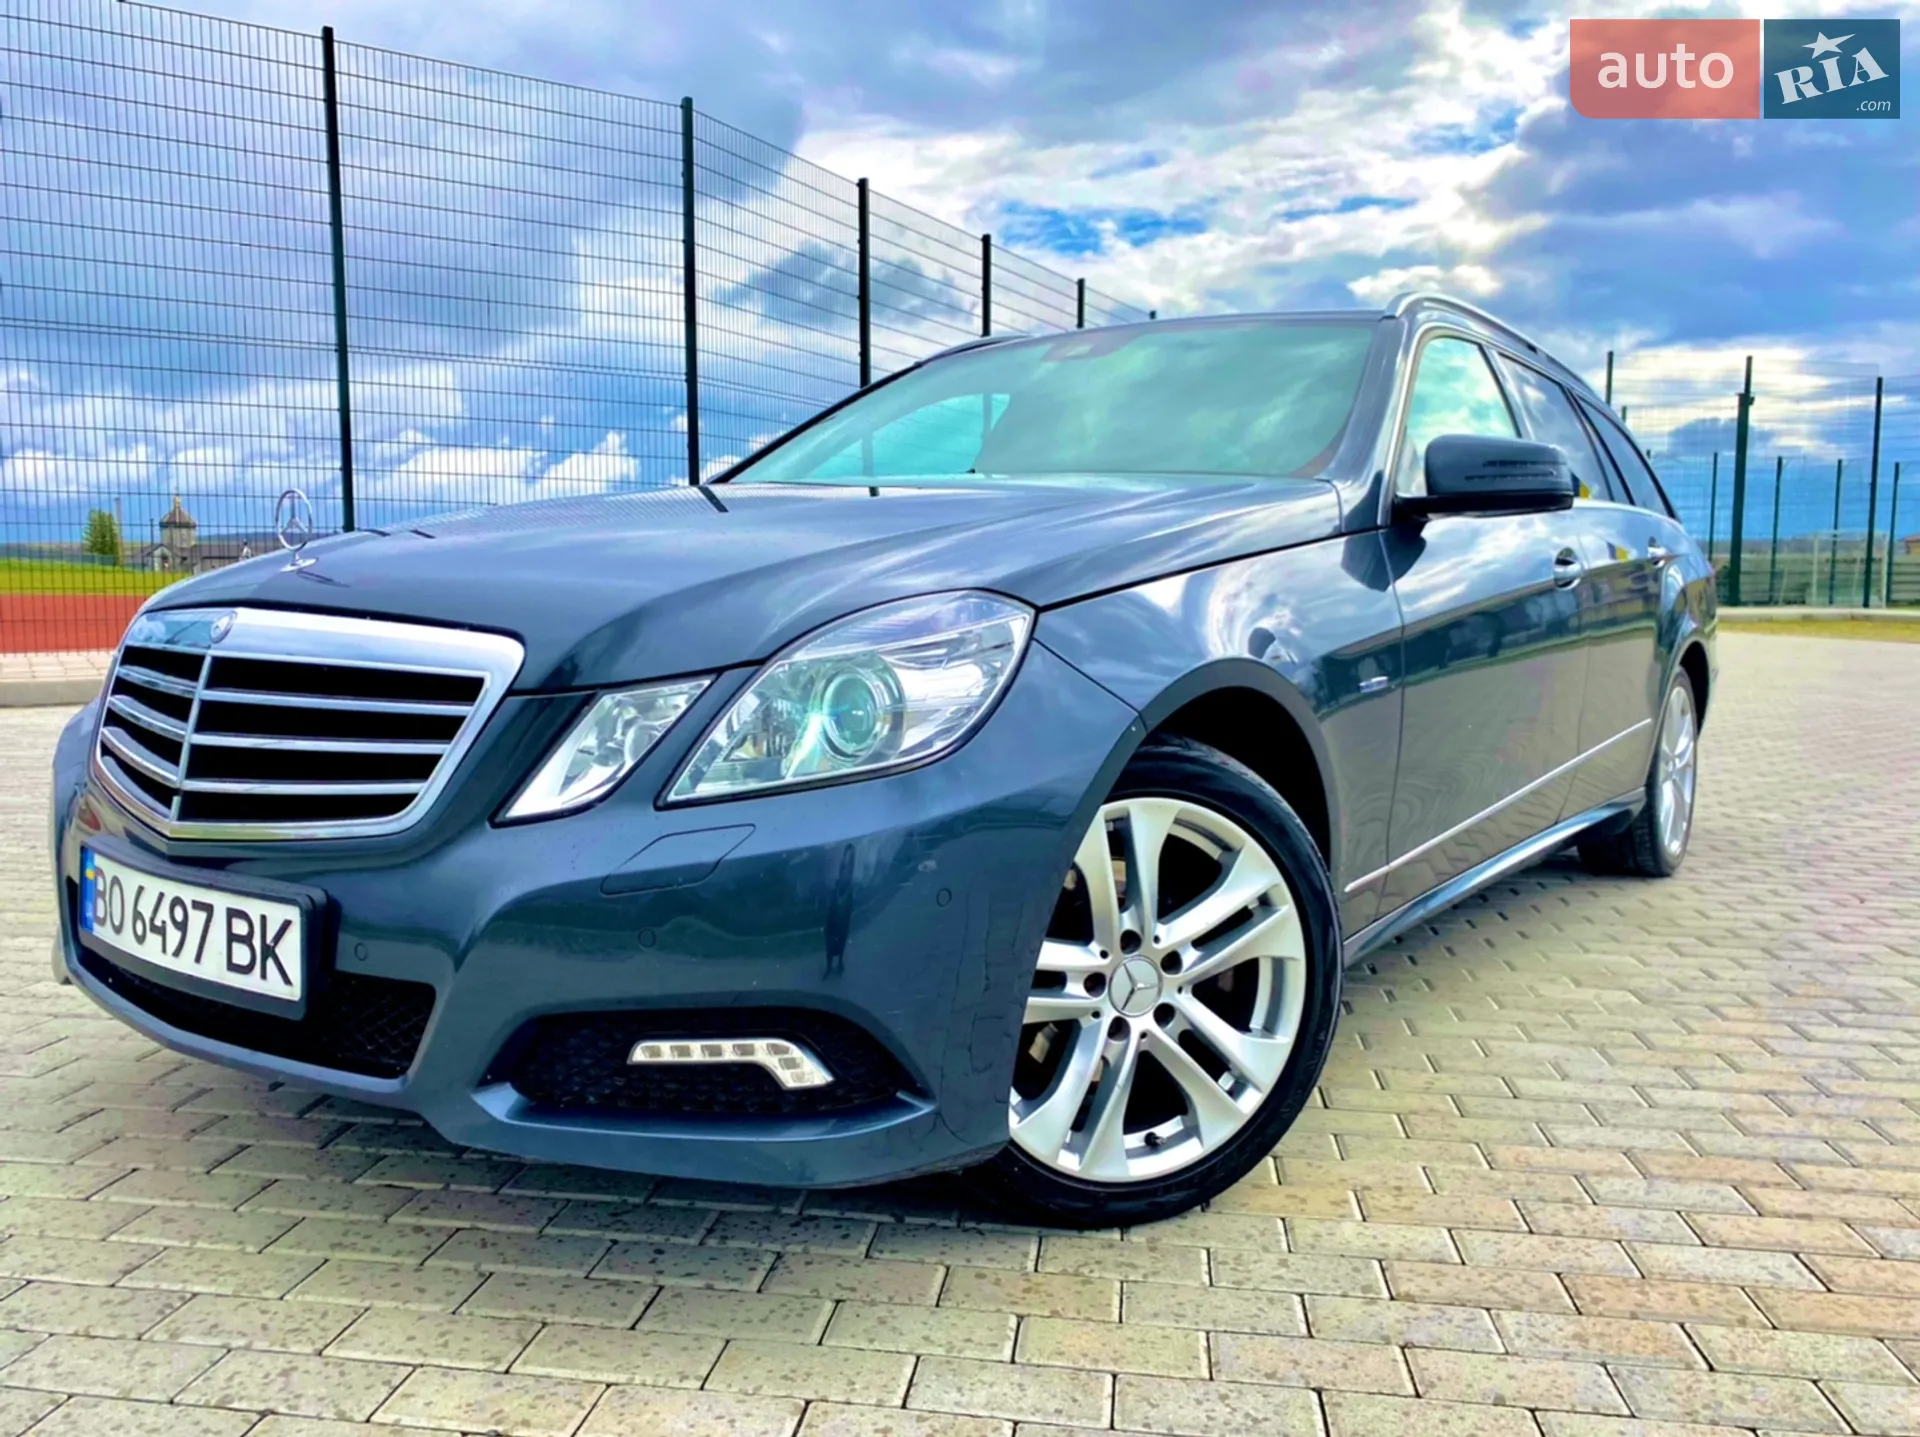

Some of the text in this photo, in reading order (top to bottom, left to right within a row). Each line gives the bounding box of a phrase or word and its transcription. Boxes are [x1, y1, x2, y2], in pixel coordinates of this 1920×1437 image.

[95, 867, 293, 986] BO 6497 BK
